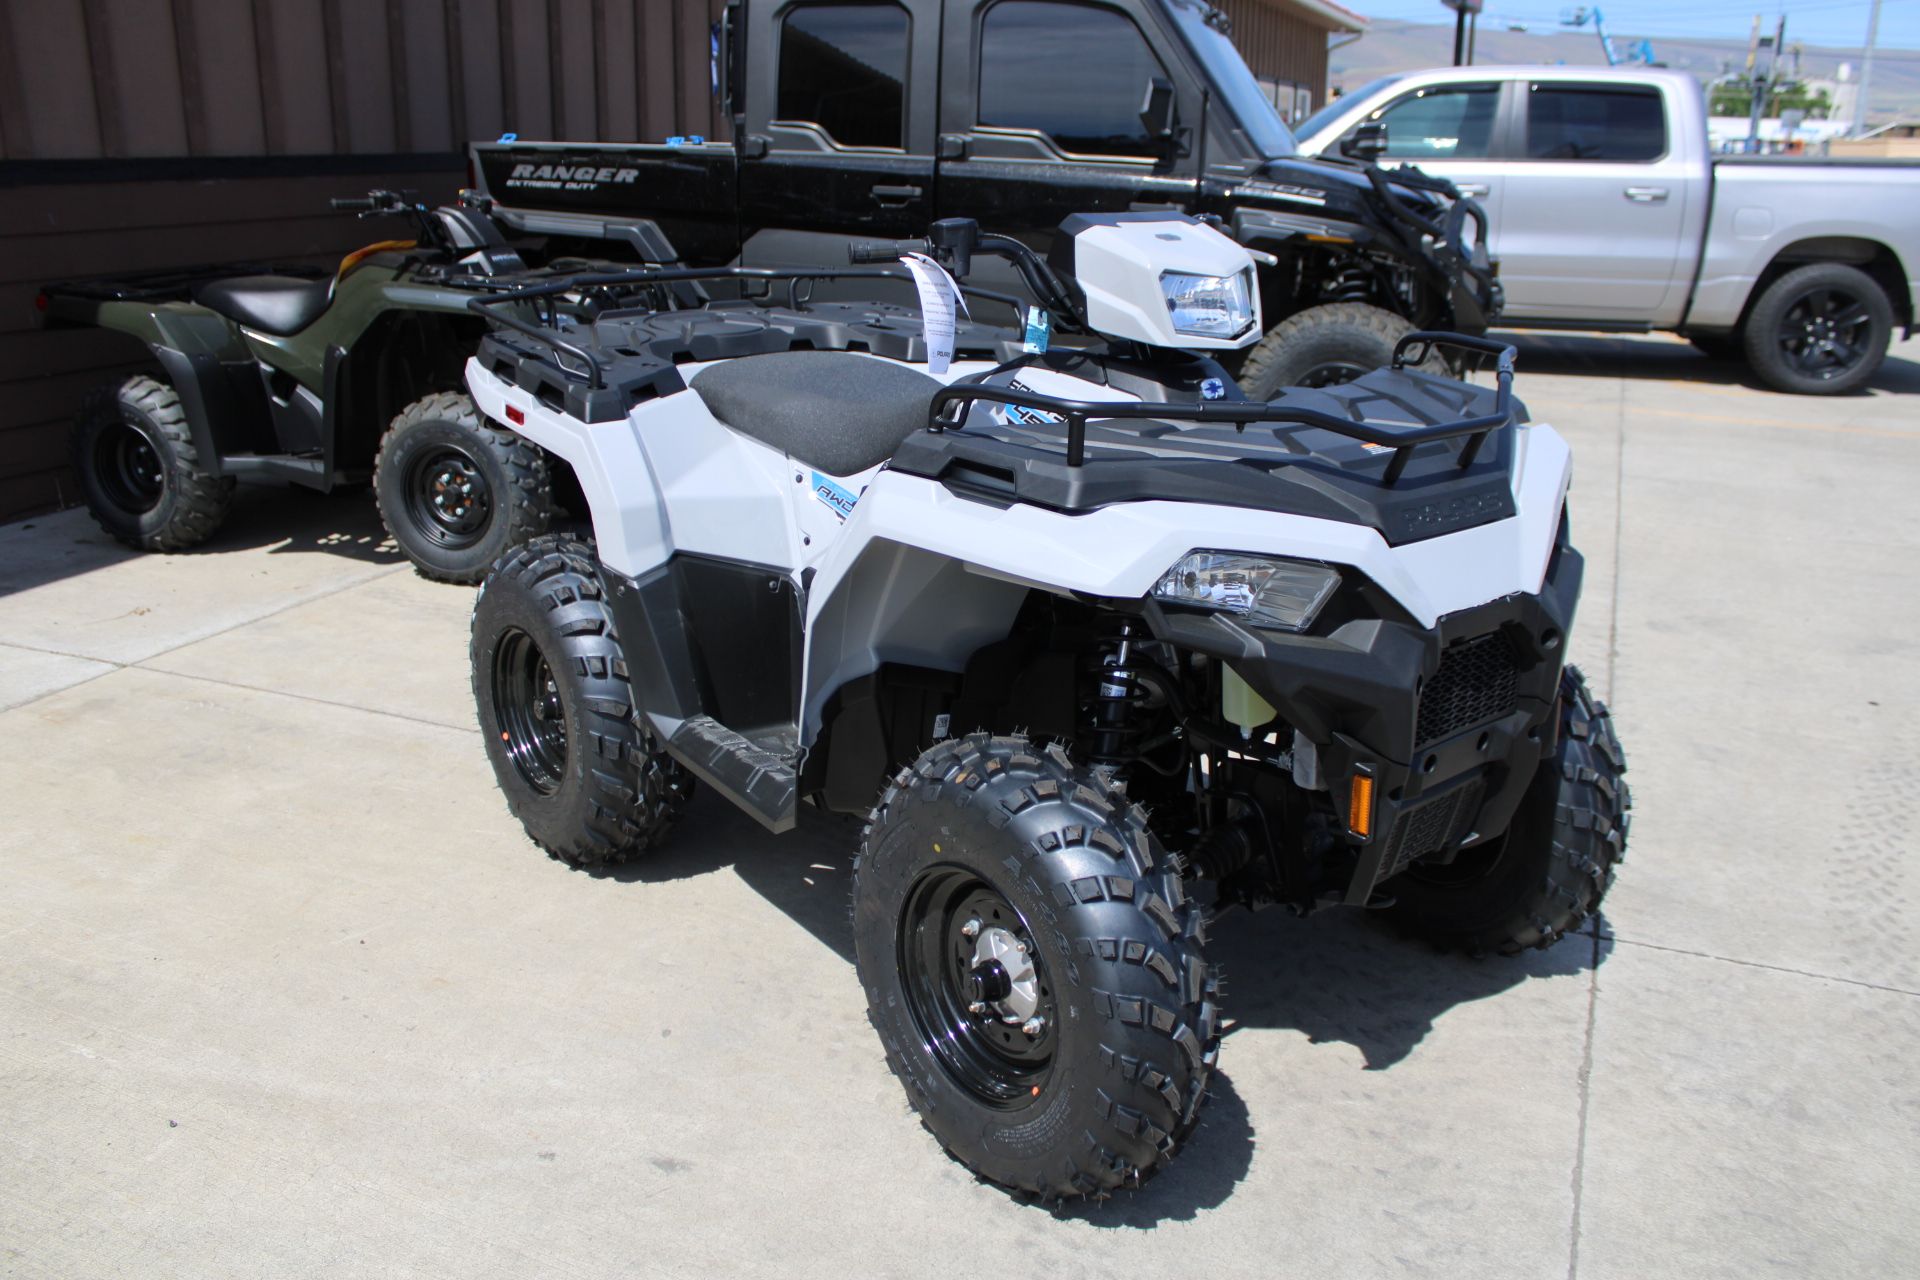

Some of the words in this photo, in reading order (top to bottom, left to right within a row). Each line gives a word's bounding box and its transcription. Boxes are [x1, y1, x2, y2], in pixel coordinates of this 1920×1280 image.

[505, 178, 563, 189] EXTREME
[565, 181, 598, 191] DUTY
[511, 163, 640, 184] RANGER
[816, 485, 857, 513] AWD
[1401, 492, 1504, 532] POLARIS
